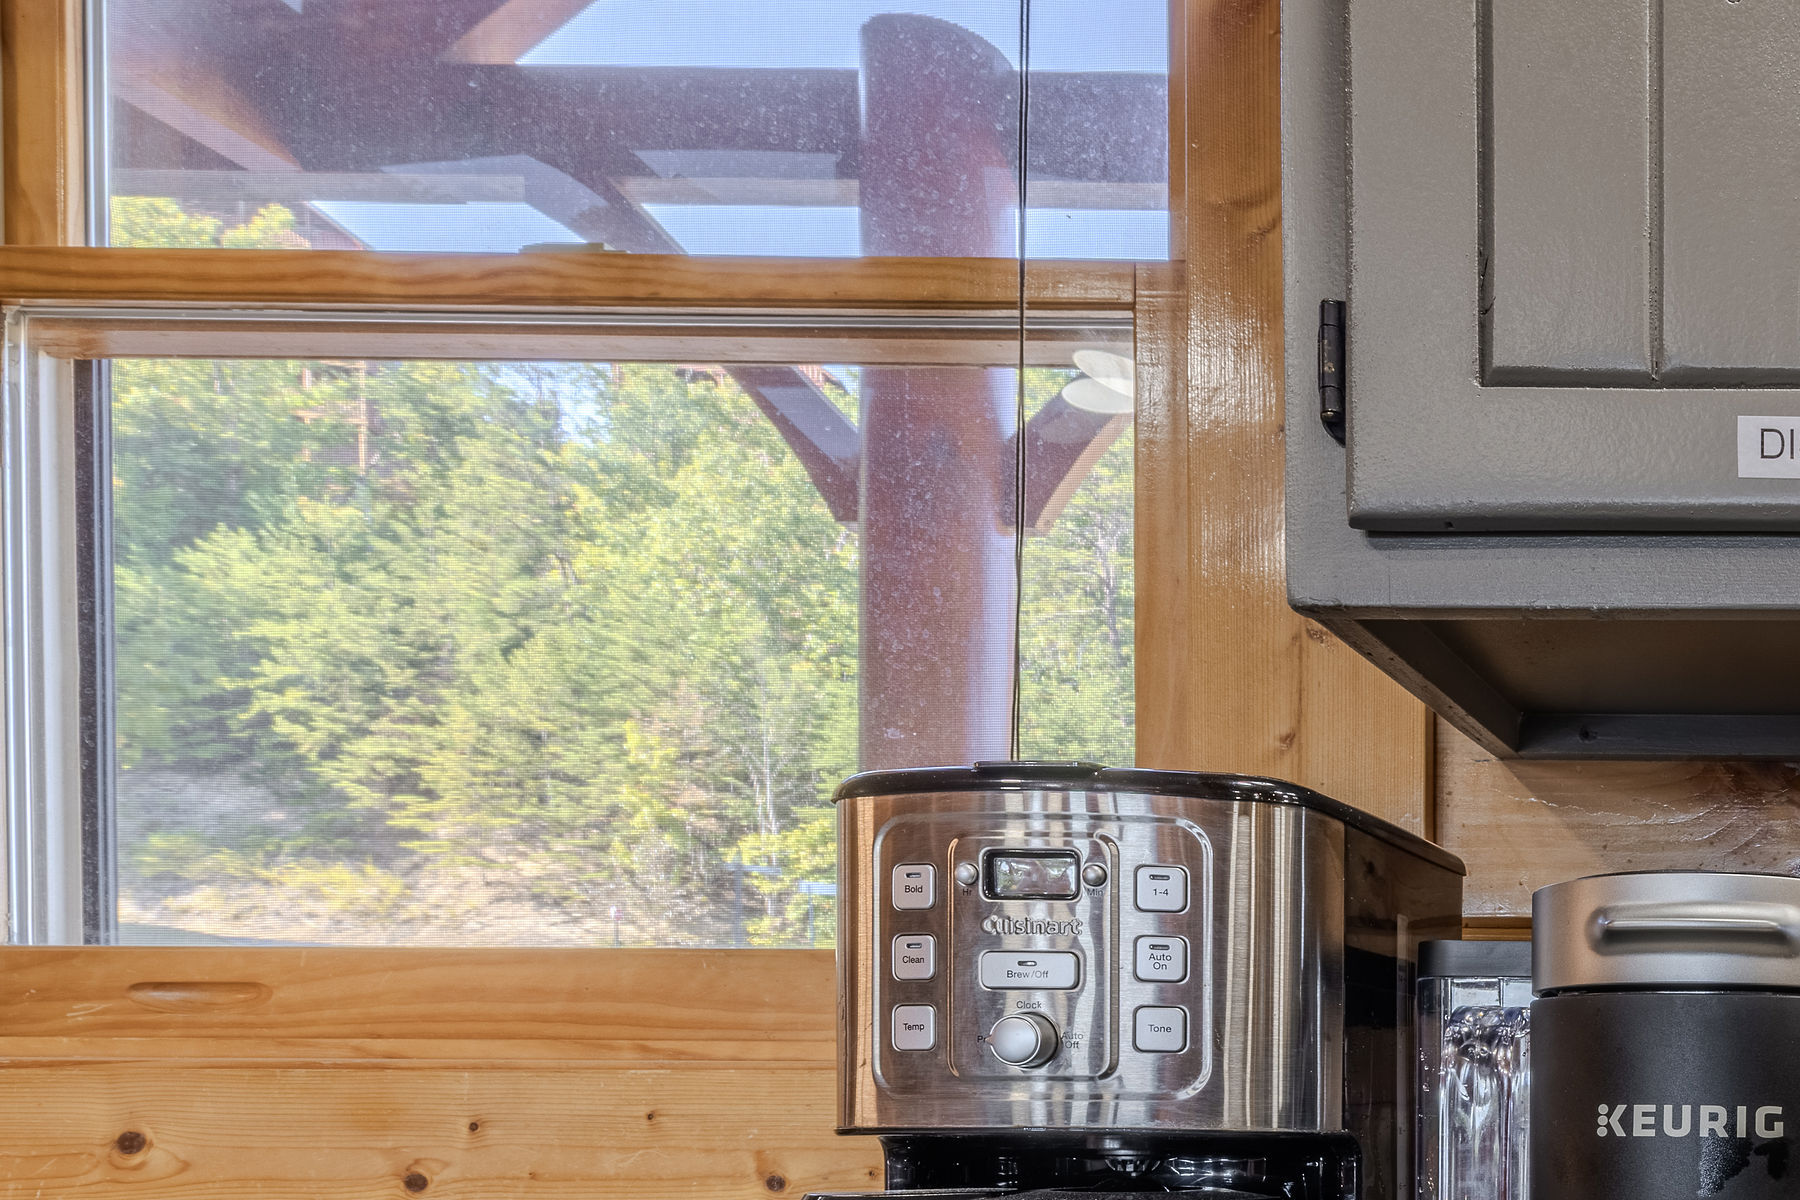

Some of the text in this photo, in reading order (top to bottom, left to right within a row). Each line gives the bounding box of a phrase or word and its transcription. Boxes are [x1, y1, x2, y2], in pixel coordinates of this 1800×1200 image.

[904, 885, 923, 894] Bold
[962, 888, 973, 897] Hr
[1152, 888, 1169, 896] 1-4
[981, 914, 1083, 936] Cuisinart
[902, 955, 925, 964] Clean
[1149, 953, 1172, 961] Auto
[1153, 962, 1168, 970] On
[1016, 1000, 1042, 1009] Clock
[903, 1022, 925, 1032] Temp
[1148, 1024, 1172, 1033] Tone
[1061, 1031, 1084, 1040] Auto
[1065, 1041, 1080, 1049] Off
[1596, 1103, 1785, 1139] KEURIG
